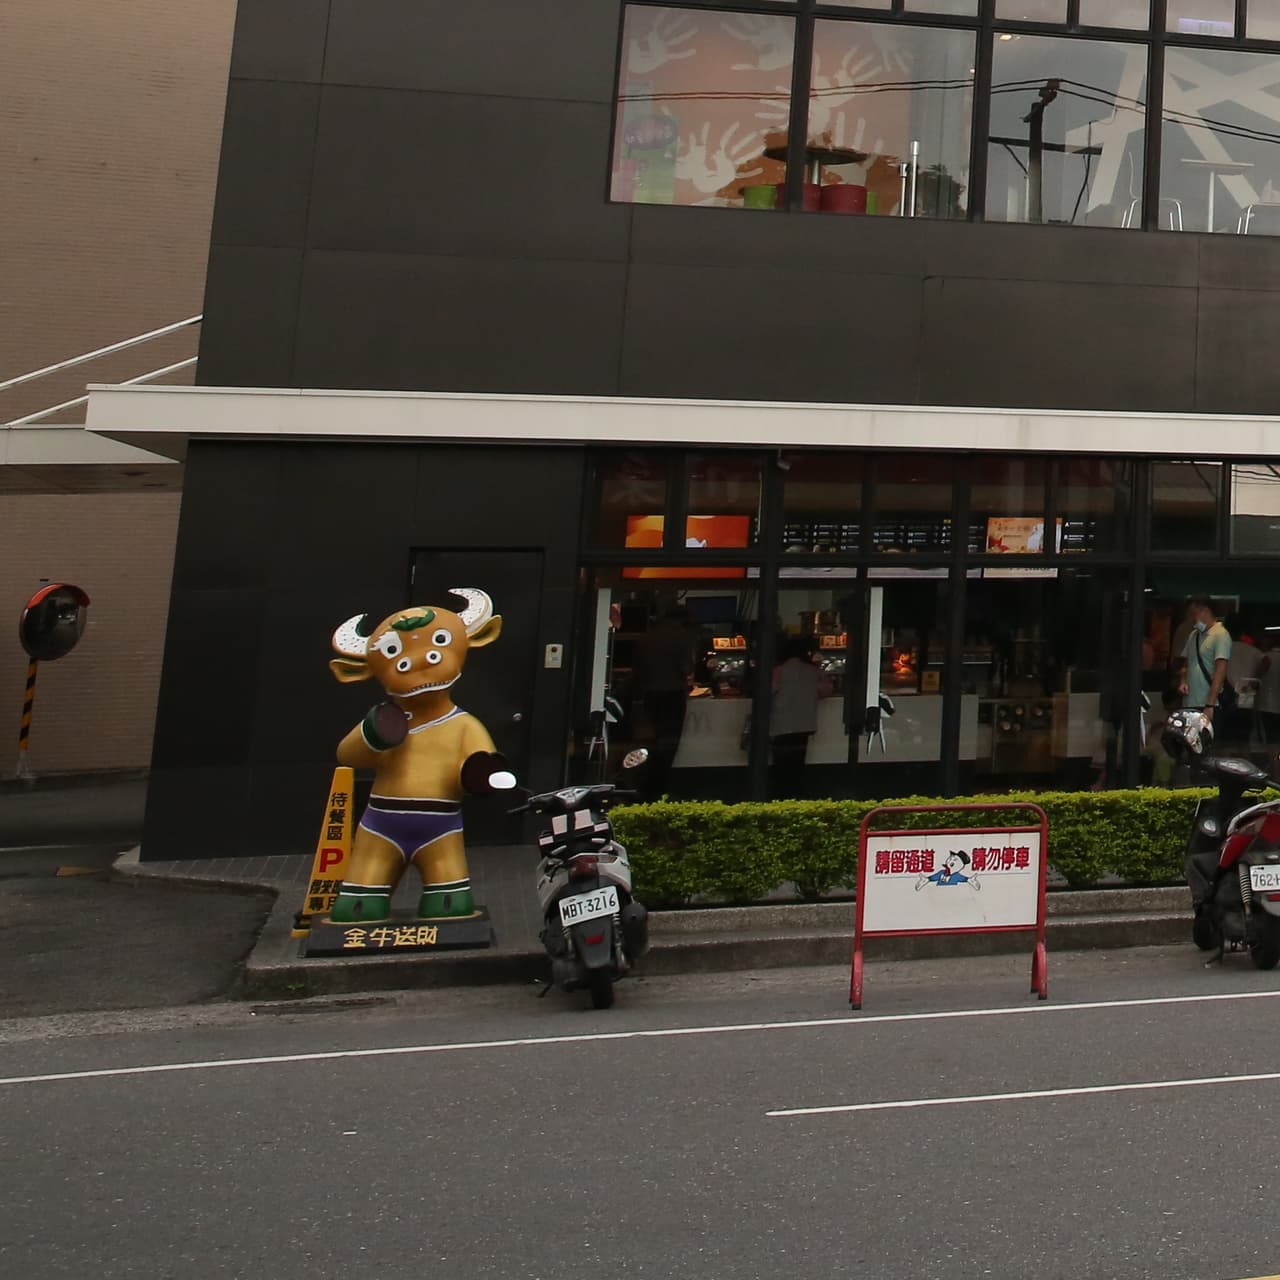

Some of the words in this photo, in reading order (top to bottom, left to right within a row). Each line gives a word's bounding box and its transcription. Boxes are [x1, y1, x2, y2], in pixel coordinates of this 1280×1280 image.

[326, 792, 348, 841] 待餐區
[319, 848, 344, 873] P
[875, 848, 936, 874] 請留通道
[972, 846, 1030, 871] 請勿停車
[562, 893, 616, 920] MBT-3216
[343, 925, 439, 948] 金牛送財
